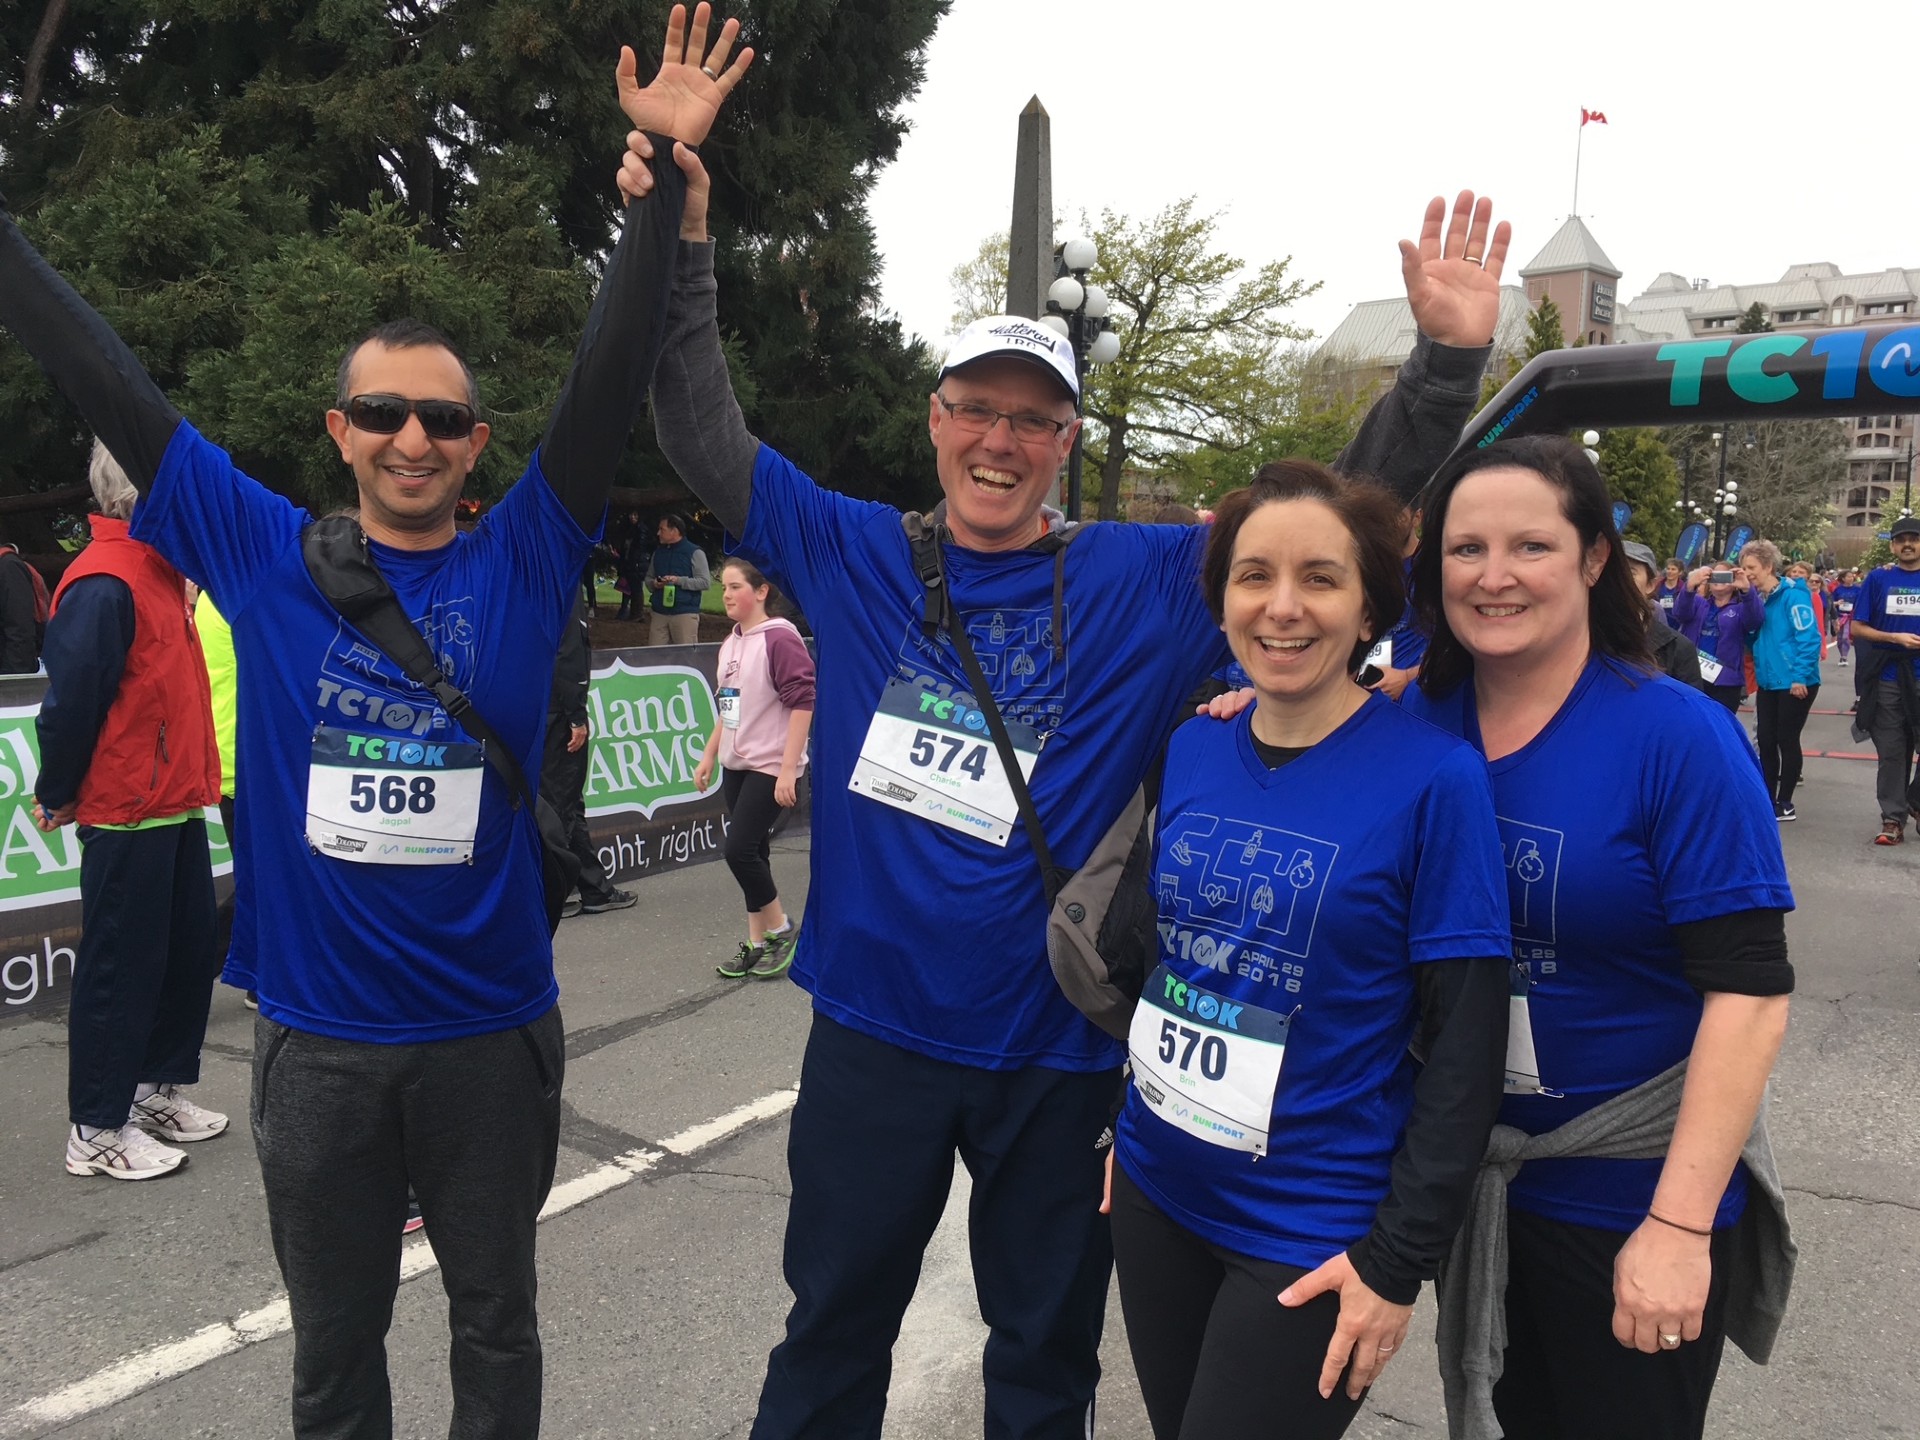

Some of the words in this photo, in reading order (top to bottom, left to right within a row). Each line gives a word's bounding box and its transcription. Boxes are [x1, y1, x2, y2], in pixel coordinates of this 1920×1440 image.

[1477, 386, 1538, 448] RUNSPORT
[1006, 704, 1044, 715] APRIL
[346, 734, 448, 767] TC10K
[585, 732, 706, 796] ARMS
[909, 729, 988, 782] 574
[350, 774, 436, 815] 568
[929, 772, 962, 788] Charles
[379, 816, 412, 828] Jagpal
[946, 807, 993, 830] RUNSPORT
[404, 846, 456, 855] RUNSPORT
[659, 818, 717, 863] right
[1239, 949, 1278, 971] APRIL
[1281, 962, 1305, 978] 29
[1531, 948, 1556, 959] 29
[1237, 962, 1303, 994] 2018
[1163, 973, 1244, 1030] TC10K
[1158, 1018, 1228, 1081] 570
[1179, 1073, 1197, 1088] Brin
[1192, 1113, 1245, 1140] RUNSPORT
